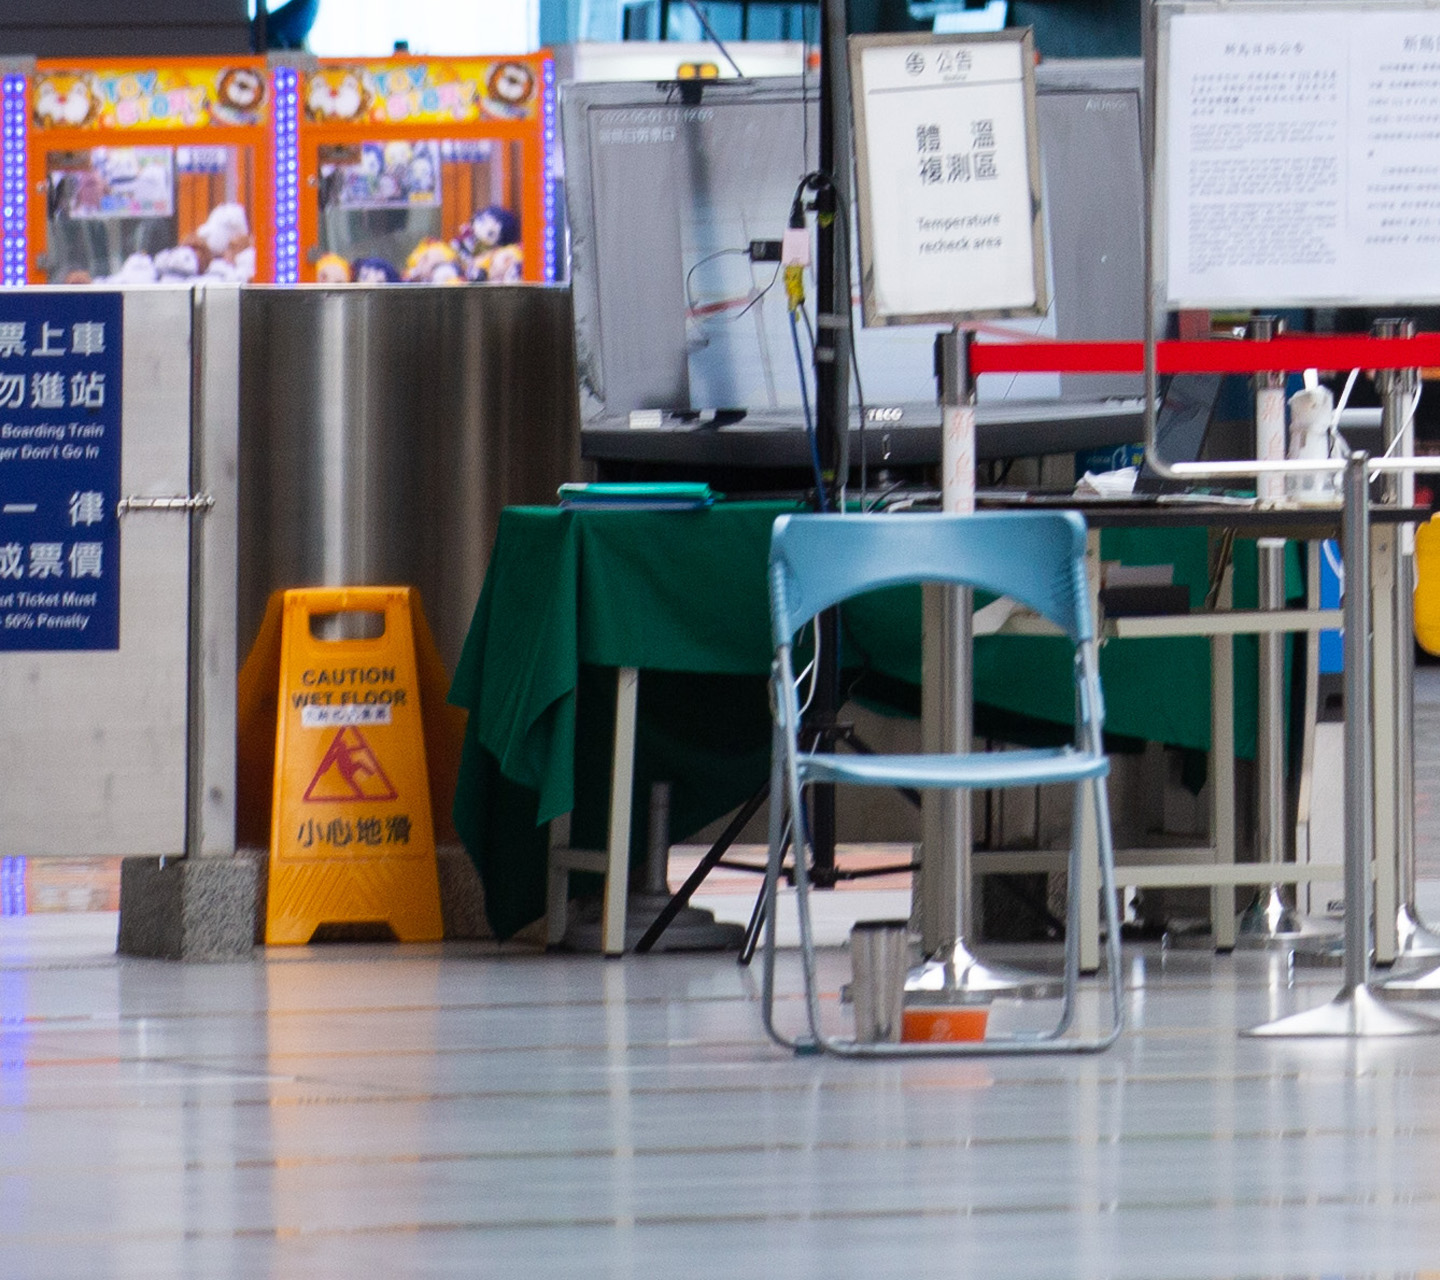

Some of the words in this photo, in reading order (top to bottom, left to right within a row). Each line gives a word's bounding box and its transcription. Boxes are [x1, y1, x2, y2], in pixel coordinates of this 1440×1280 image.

[2, 423, 65, 441] Boarding
[69, 423, 105, 439] Train
[21, 444, 61, 460] Don't
[62, 444, 82, 460] Go
[16, 592, 60, 608] Ticket
[62, 592, 97, 607] Must
[37, 614, 90, 631] Penalty
[302, 668, 396, 686] CAUTION
[297, 815, 412, 848] 小心地滑
